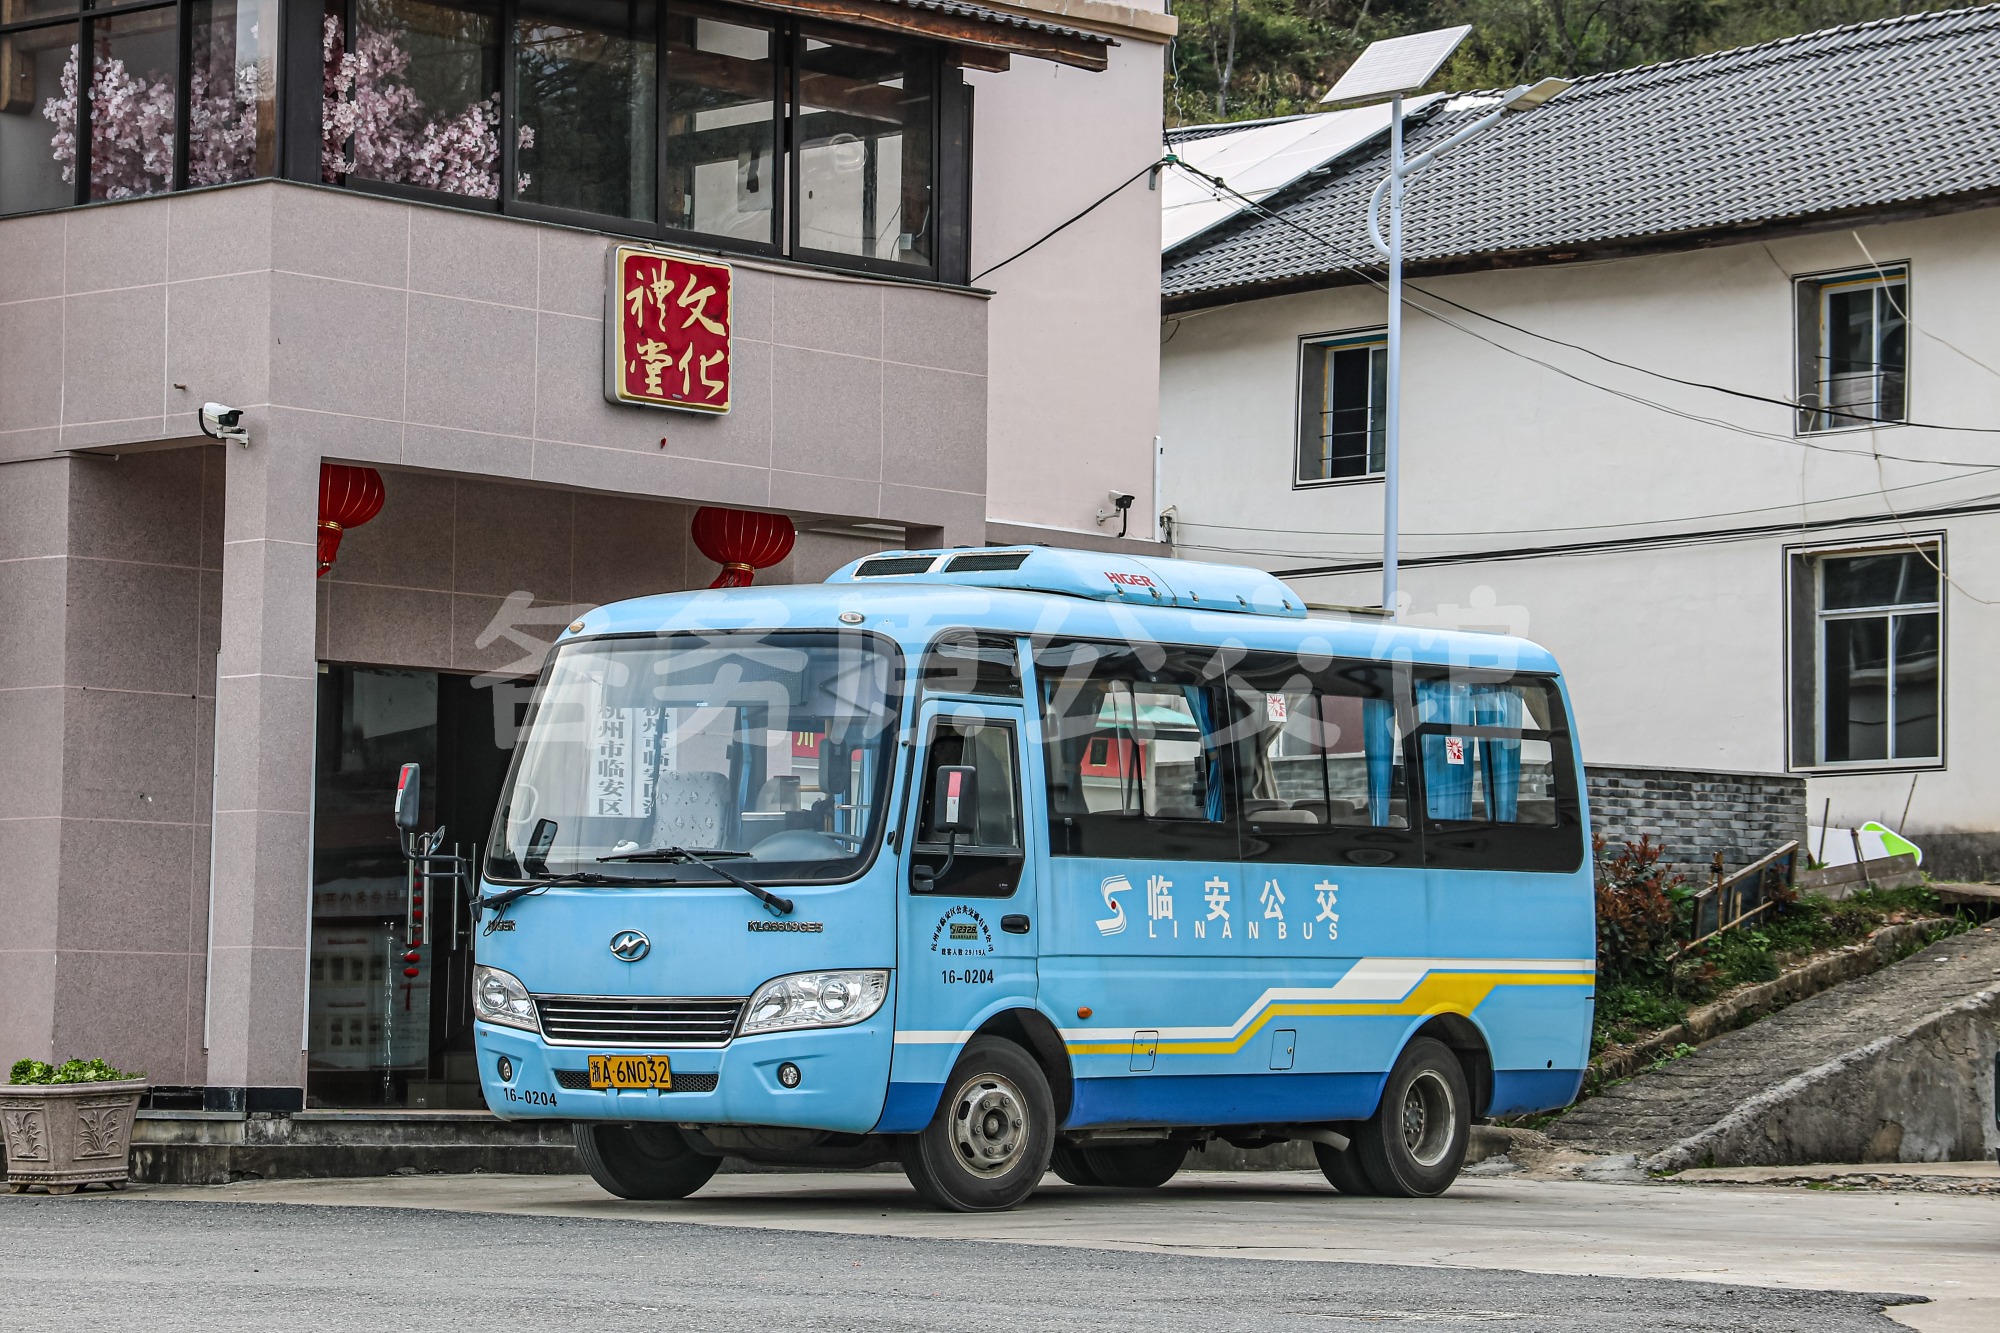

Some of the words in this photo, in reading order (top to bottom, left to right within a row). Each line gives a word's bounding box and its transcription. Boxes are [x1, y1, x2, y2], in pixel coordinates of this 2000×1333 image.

[1103, 571, 1157, 588] HIGER
[1146, 874, 1340, 923] 临安公交
[941, 969, 994, 984] 16-0204
[503, 1087, 558, 1107] 16-0204
